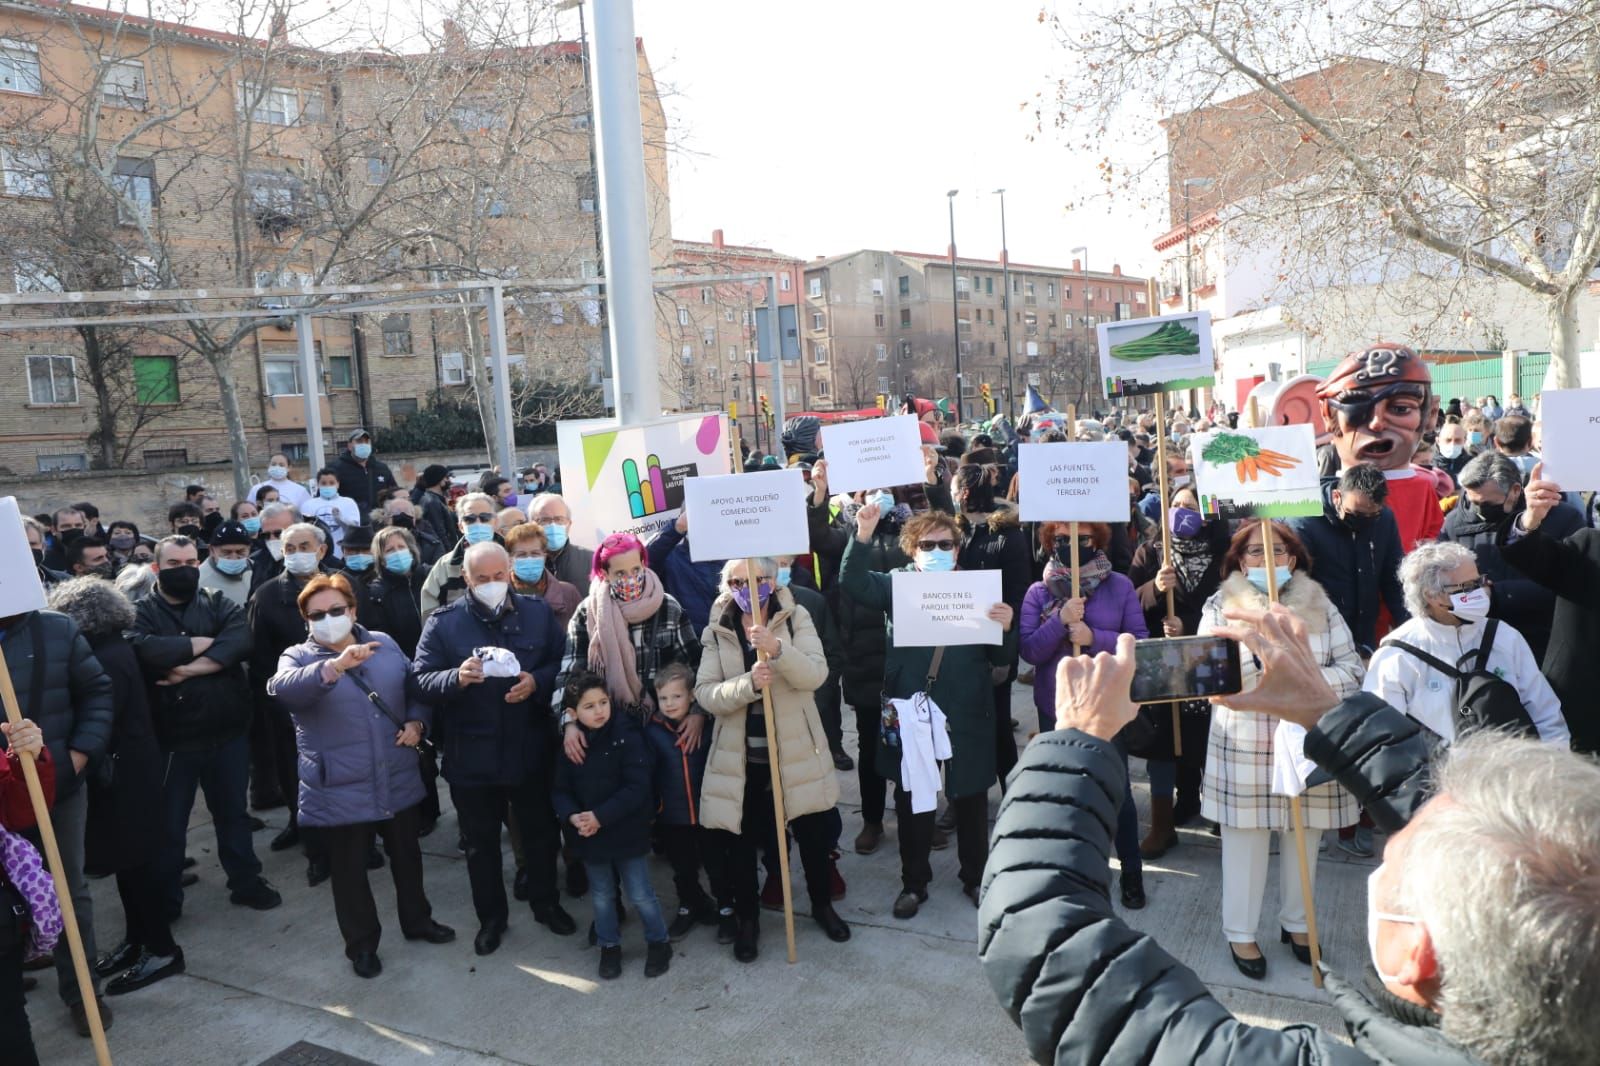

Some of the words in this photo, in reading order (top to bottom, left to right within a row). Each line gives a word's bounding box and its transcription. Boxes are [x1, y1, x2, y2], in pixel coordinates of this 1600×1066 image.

[1049, 464, 1062, 472] LAS
[1063, 463, 1096, 472] FUENTES,
[1046, 477, 1061, 486] ¿UN
[1063, 477, 1089, 485] BARRIO
[711, 497, 734, 505] APOYO
[735, 496, 744, 504] AL
[746, 492, 779, 503] PEQUEÑO
[721, 507, 757, 516] COMERCIO
[734, 518, 760, 527] BARRIO
